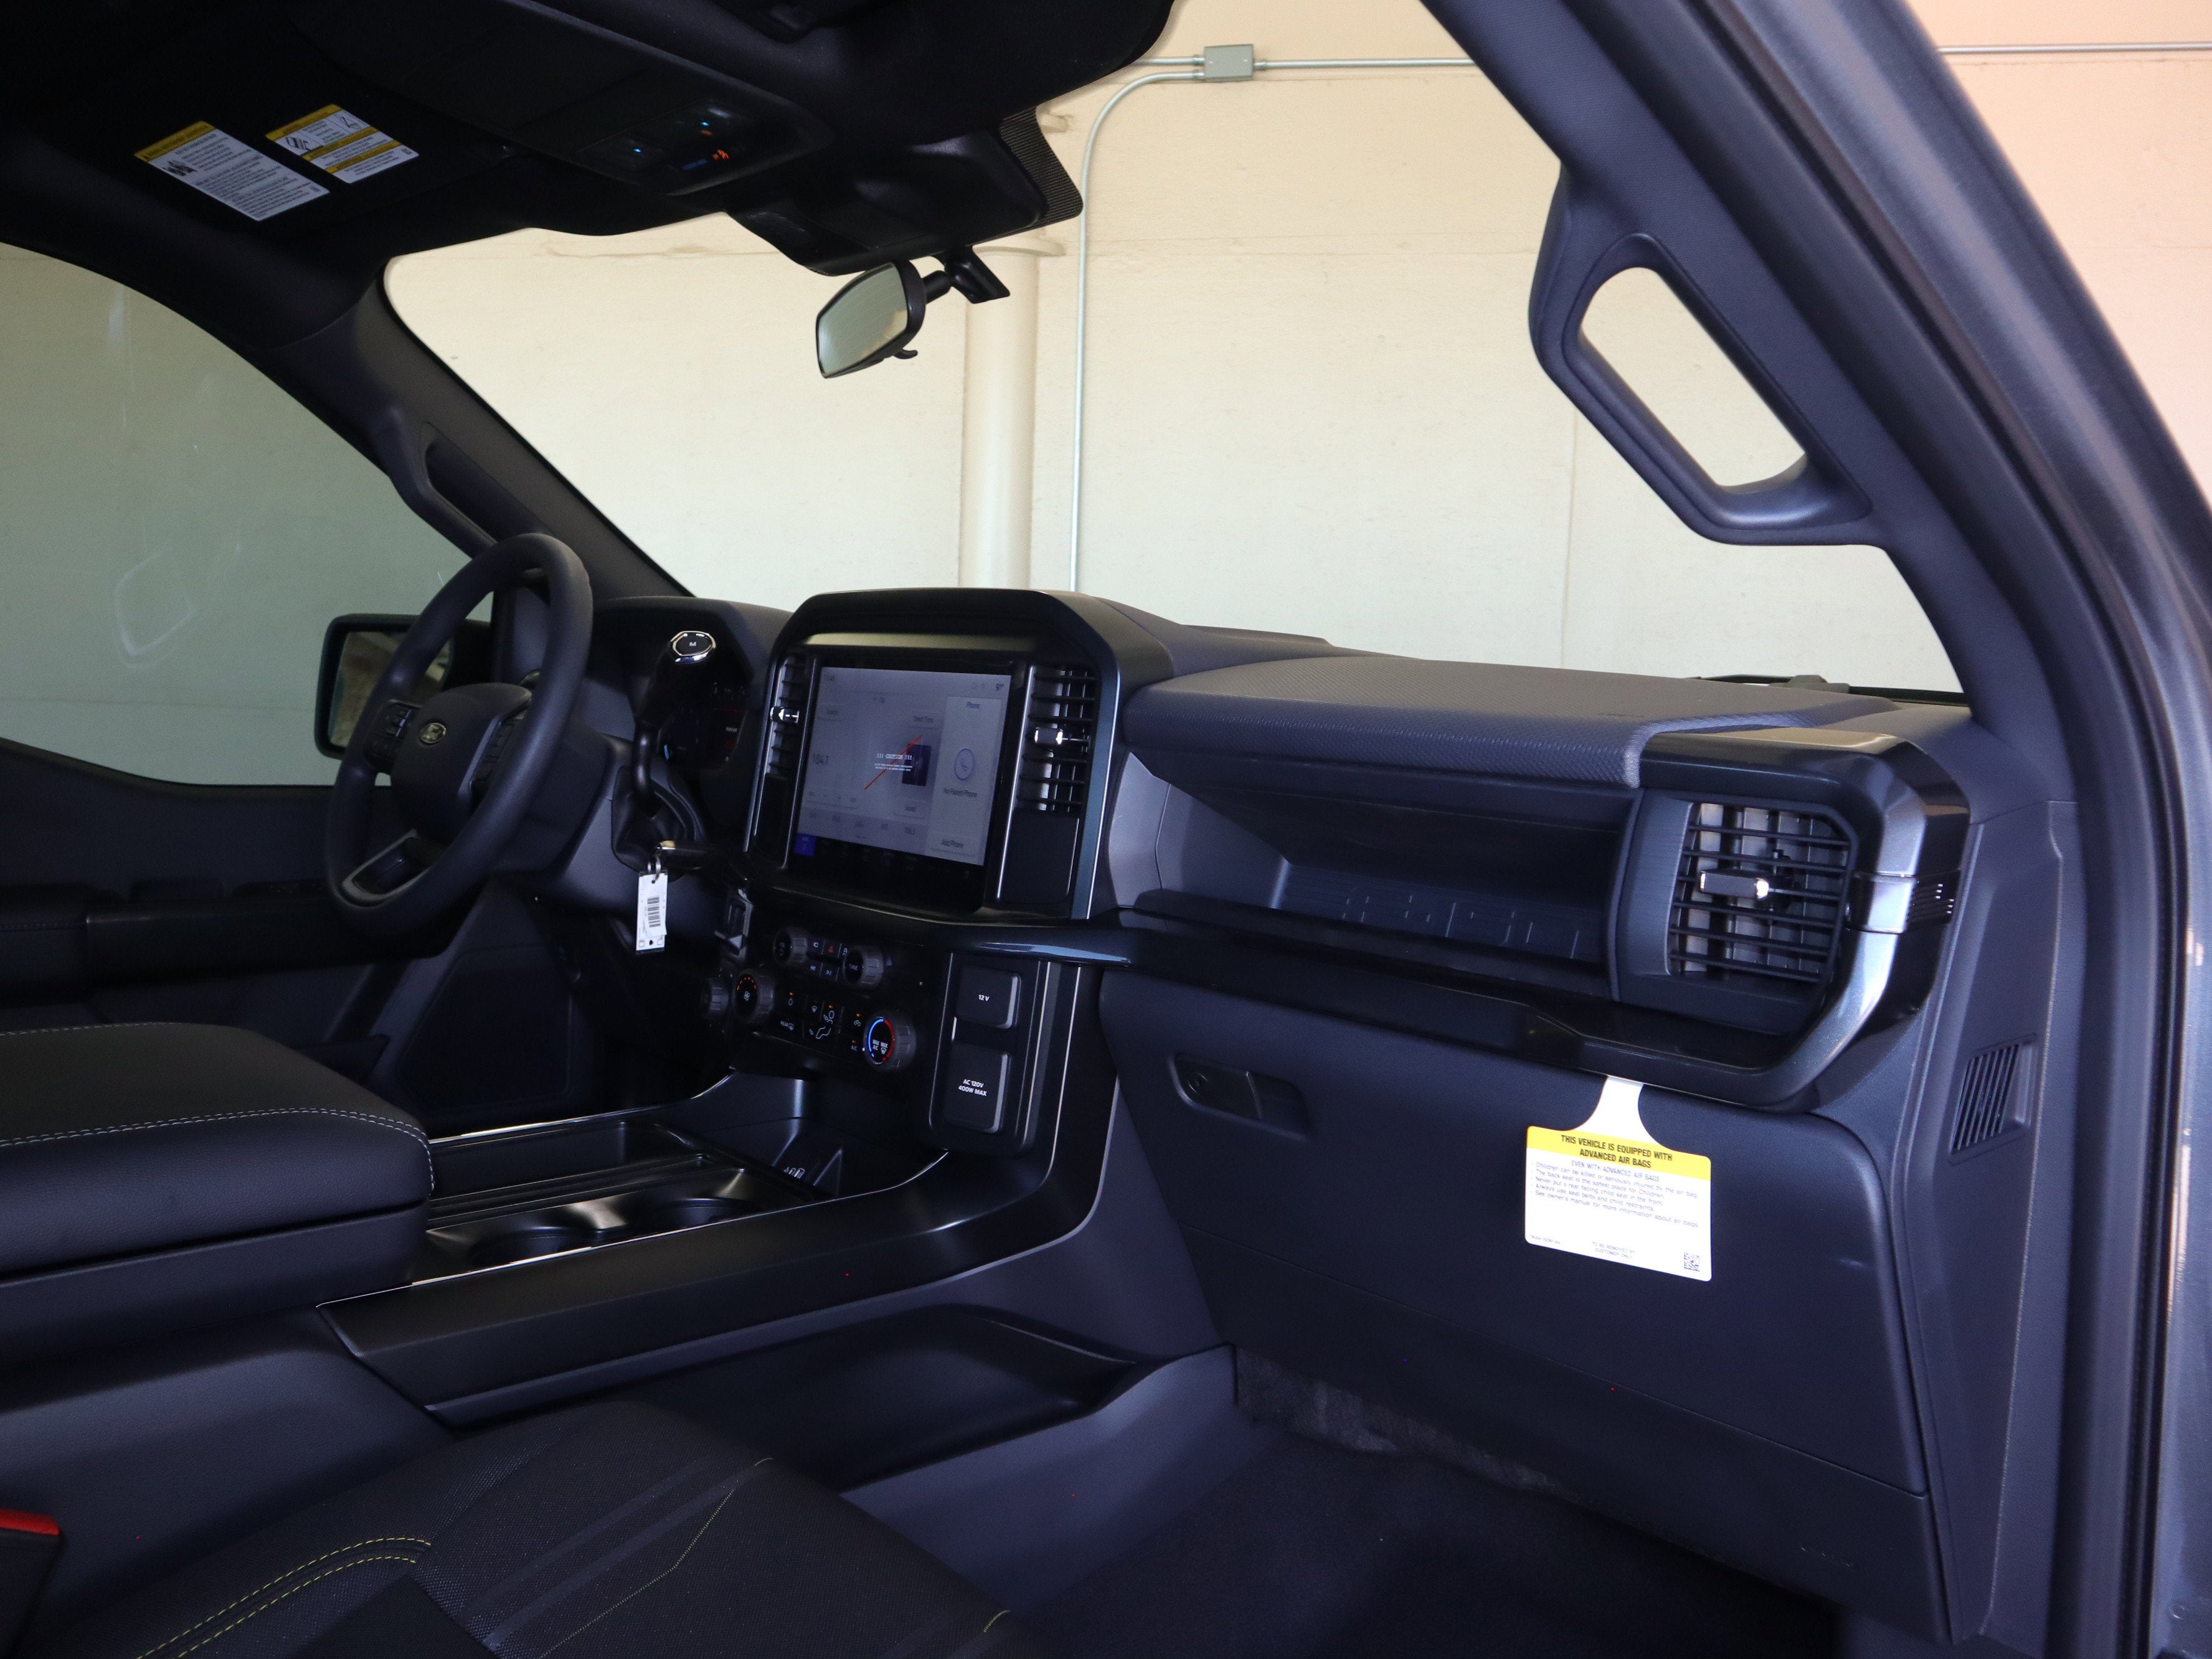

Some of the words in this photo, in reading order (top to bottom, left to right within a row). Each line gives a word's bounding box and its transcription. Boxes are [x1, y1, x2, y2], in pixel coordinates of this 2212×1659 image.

[958, 1085, 973, 1094] 400W
[974, 1088, 988, 1097] MAX
[1561, 1135, 1576, 1144] THIS
[1578, 1138, 1606, 1150] VEHICLE
[1617, 1145, 1652, 1157] EQUIPPED
[1653, 1151, 1672, 1161] WITH
[1579, 1148, 1616, 1161] ADVANCED
[1619, 1156, 1630, 1165] AIR
[1632, 1158, 1652, 1168] BAGS
[1536, 1162, 1559, 1170] Children
[1603, 1166, 1632, 1176] ADVANCED
[1645, 1174, 1660, 1182] BAGS
[1536, 1183, 1555, 1191] Always
